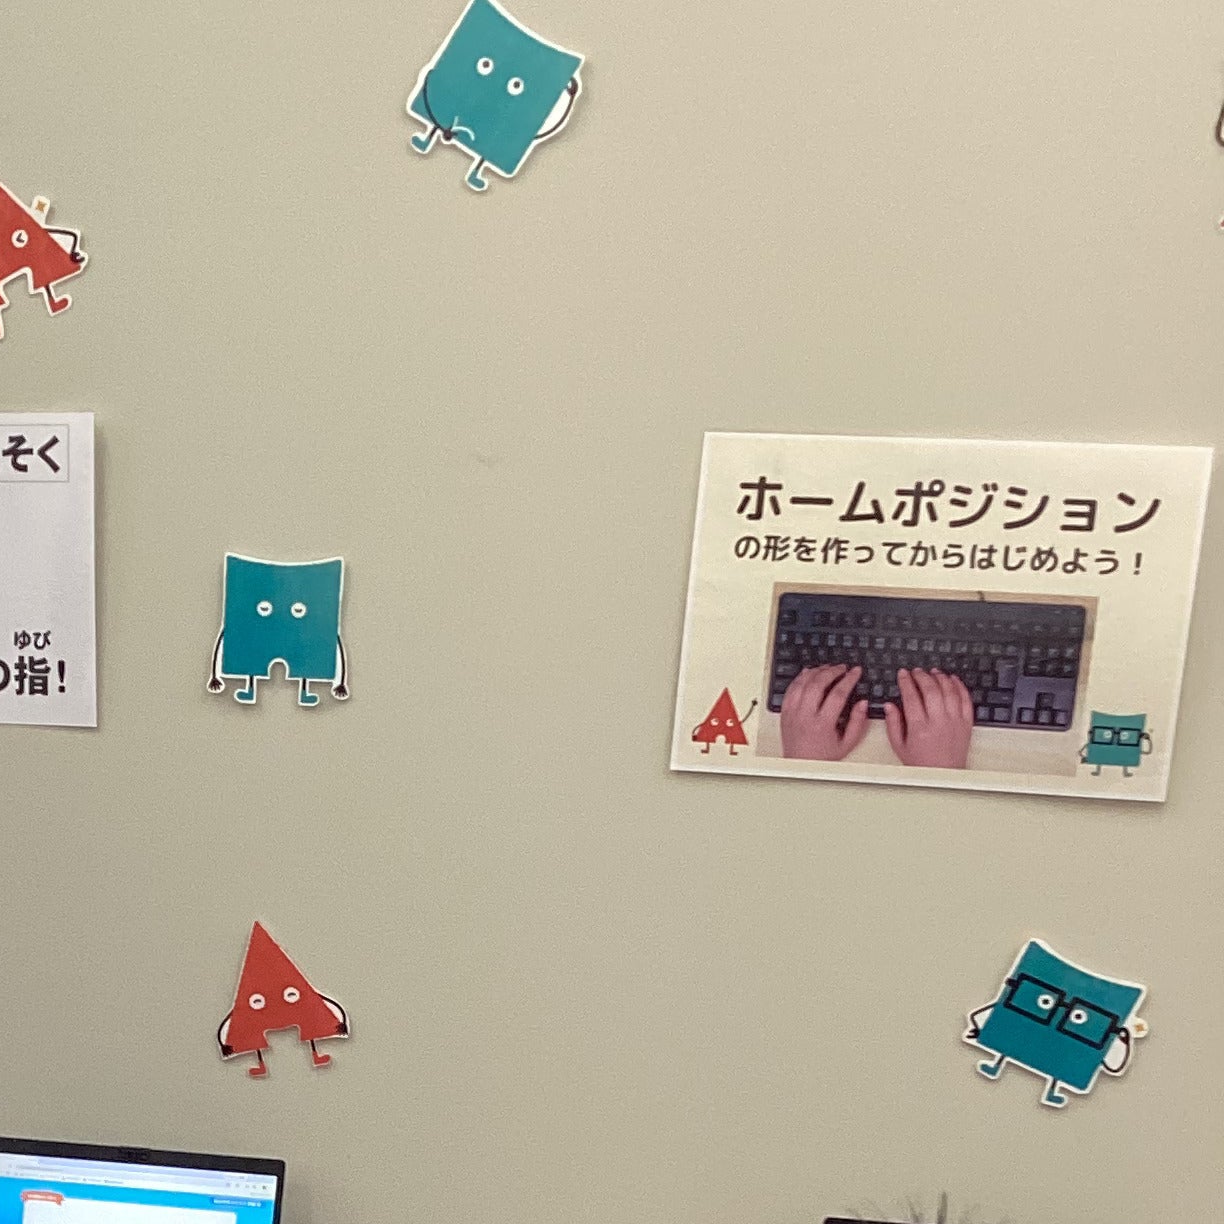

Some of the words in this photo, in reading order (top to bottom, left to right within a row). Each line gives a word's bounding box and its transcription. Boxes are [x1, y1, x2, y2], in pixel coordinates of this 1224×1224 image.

[736, 476, 1161, 533] ホームポジション
[13, 630, 51, 650] ゆび
